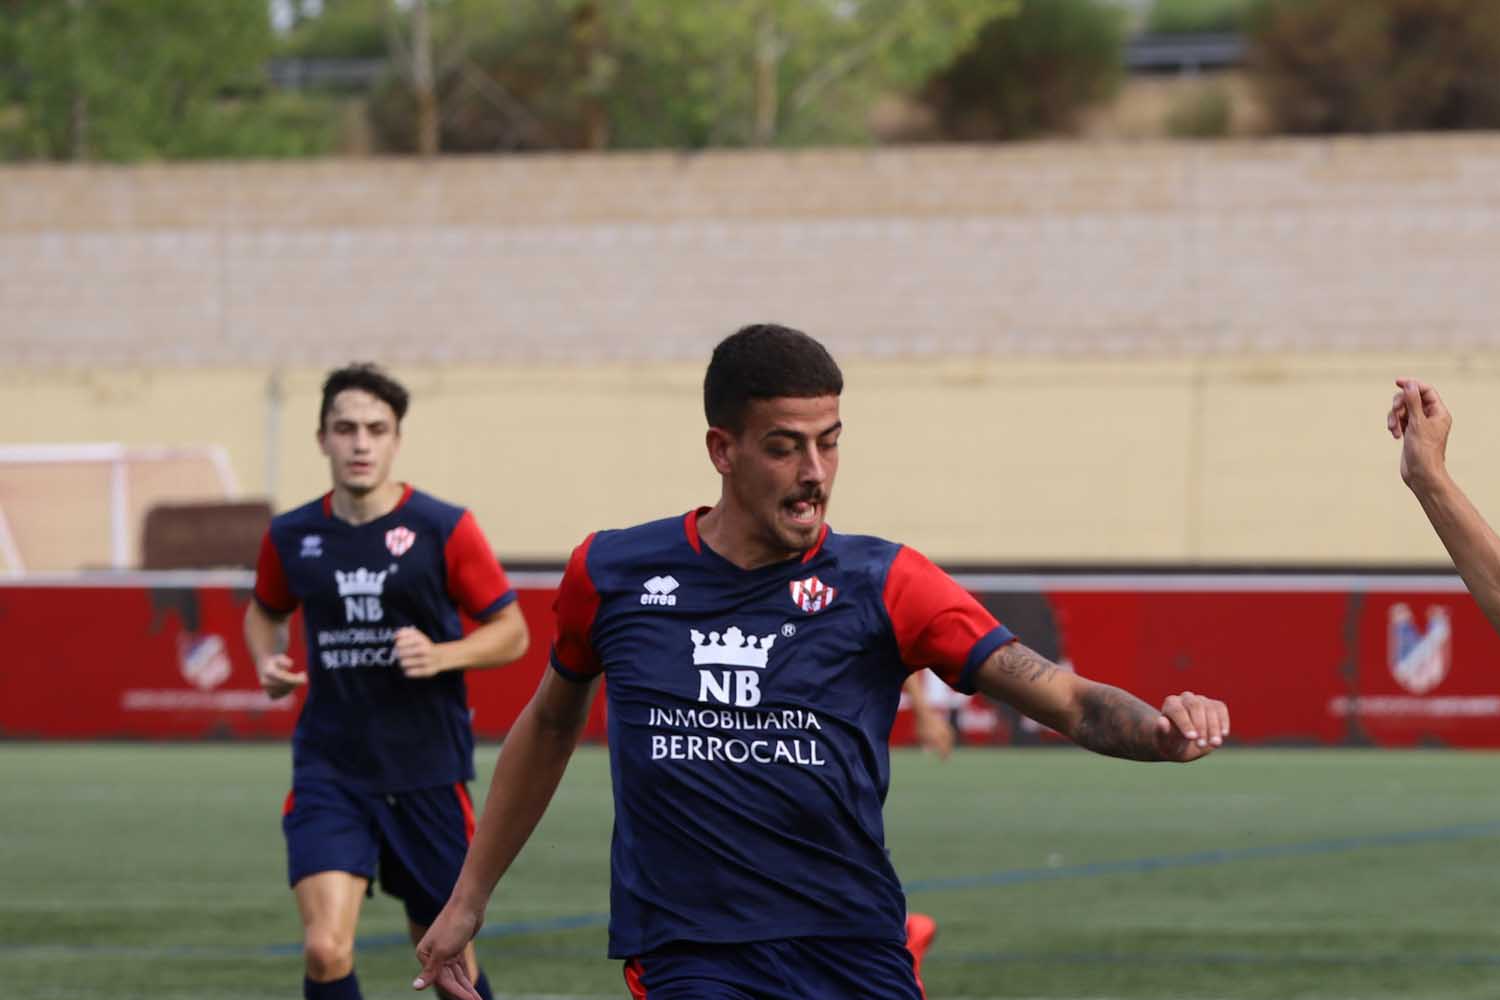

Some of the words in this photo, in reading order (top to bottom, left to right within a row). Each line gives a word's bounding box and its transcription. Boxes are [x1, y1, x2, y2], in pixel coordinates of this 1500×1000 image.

[345, 596, 384, 622] NB
[697, 669, 762, 707] NB
[649, 708, 821, 730] INMOBILIARIA
[651, 735, 825, 765] BERROCALL
